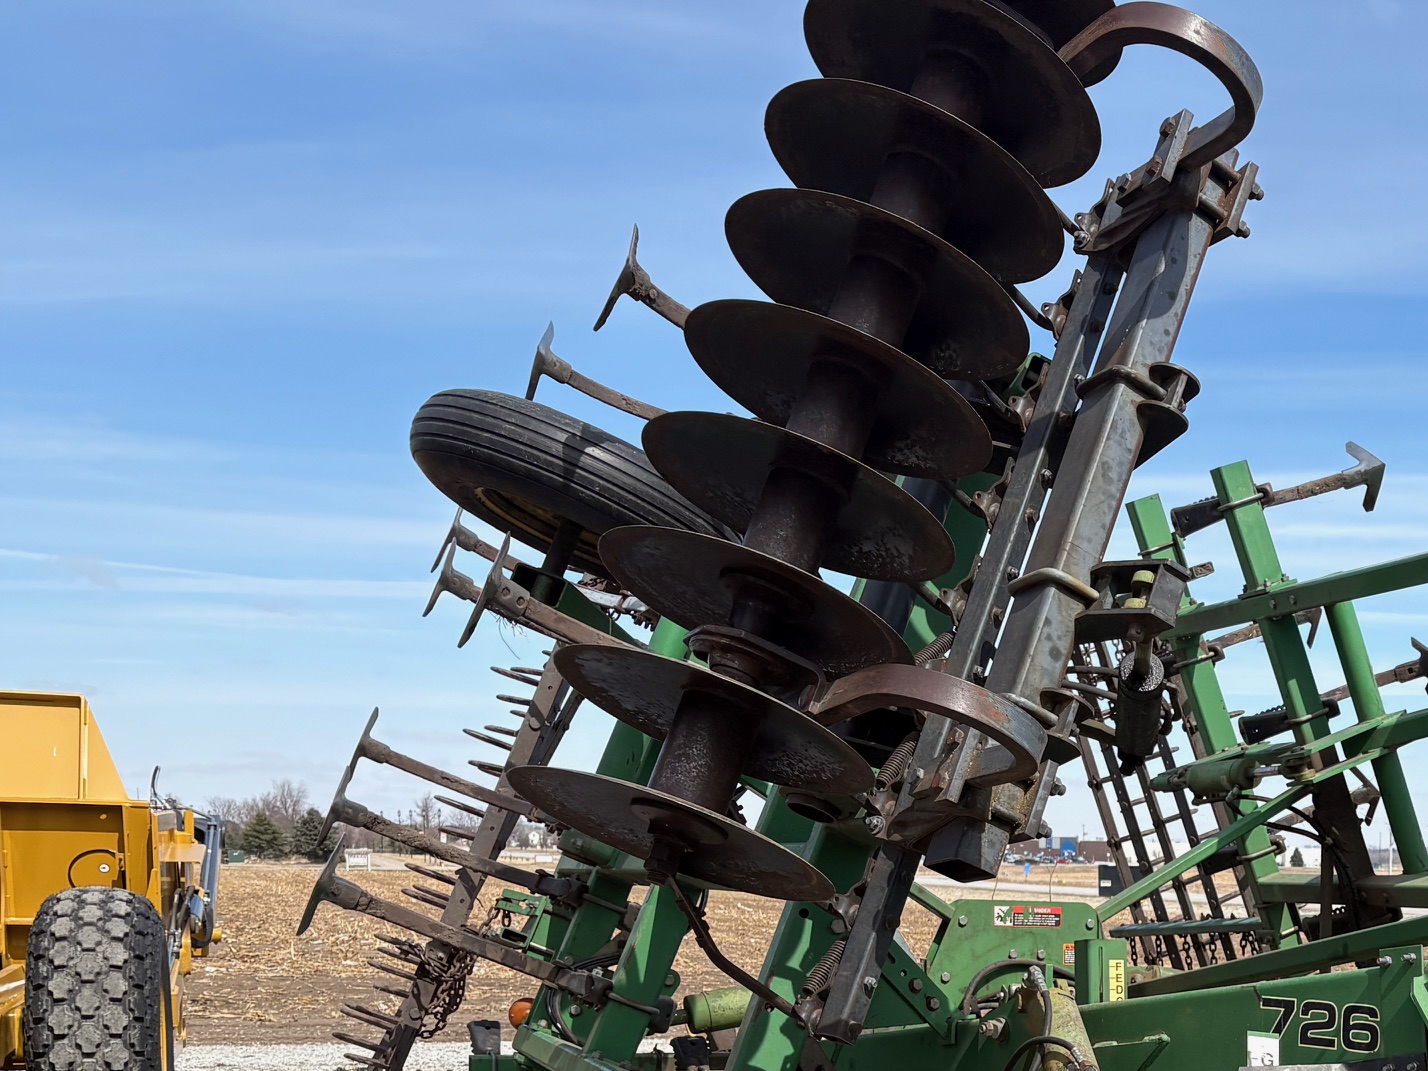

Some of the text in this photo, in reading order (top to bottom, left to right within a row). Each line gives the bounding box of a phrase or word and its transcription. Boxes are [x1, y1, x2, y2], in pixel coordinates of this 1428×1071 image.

[1115, 962, 1122, 971] F
[1115, 974, 1123, 983] E
[1116, 985, 1124, 994] D
[1260, 995, 1381, 1053] 726
[1261, 1052, 1274, 1067] G
